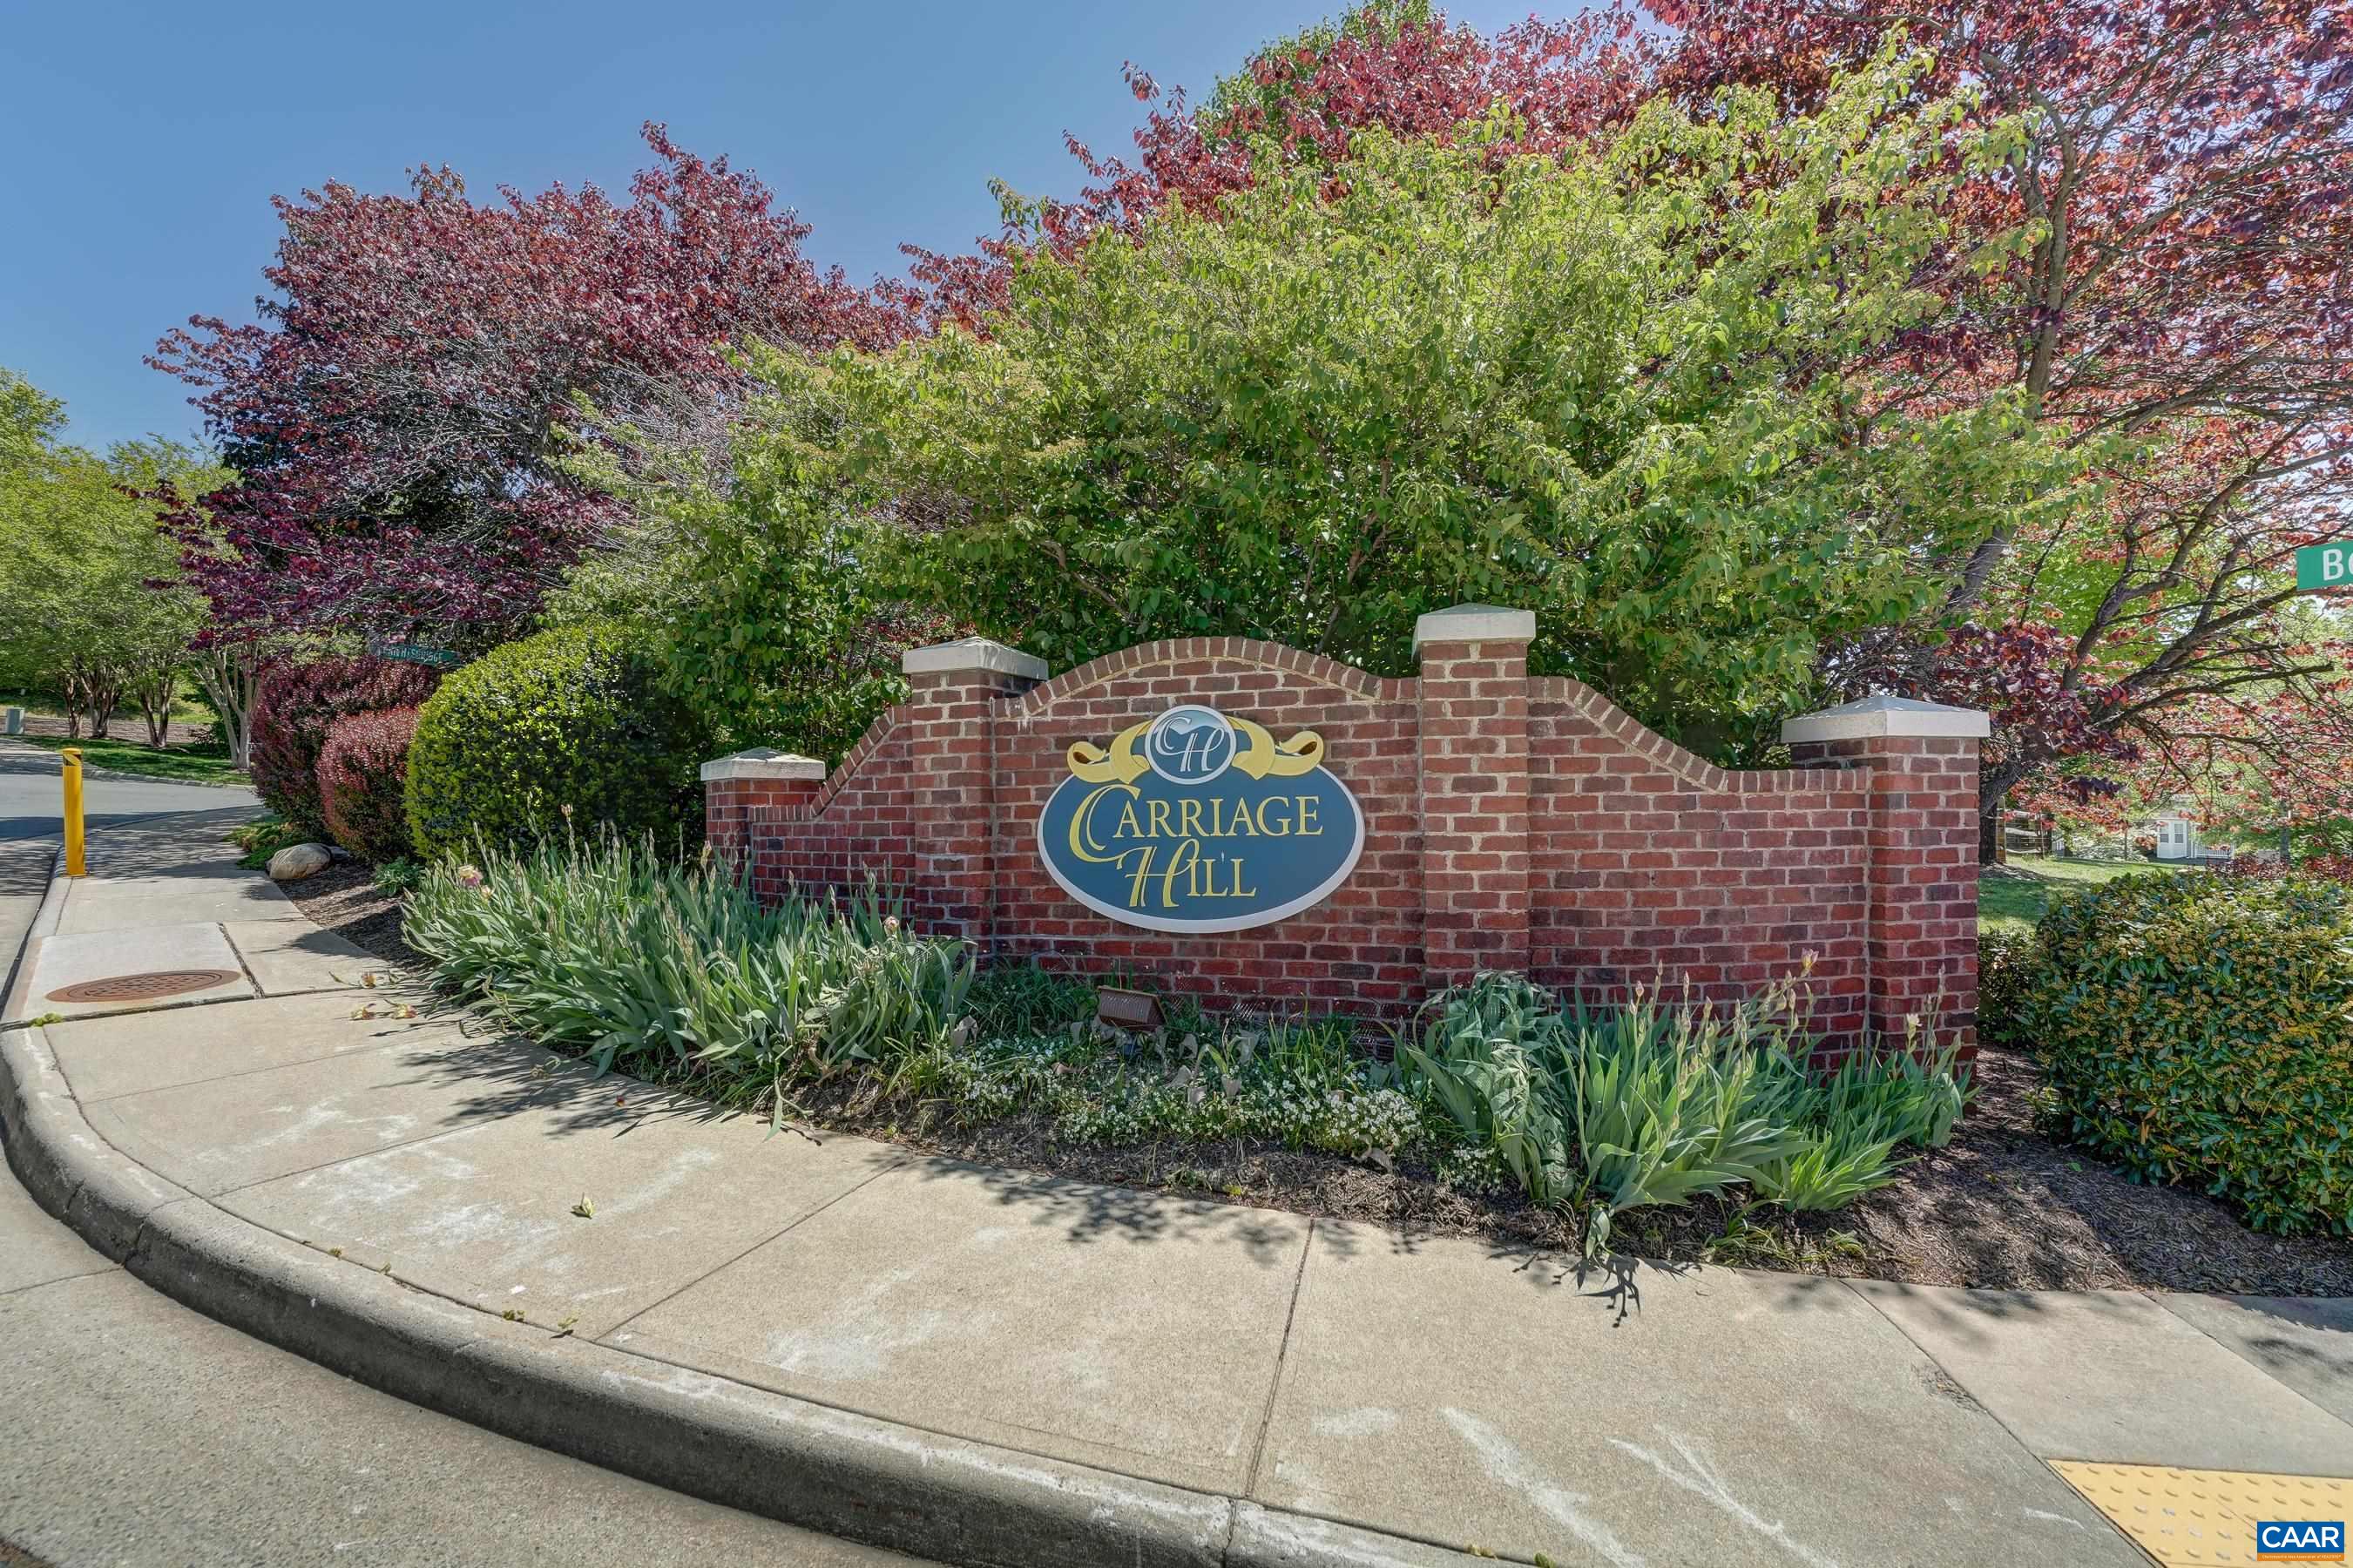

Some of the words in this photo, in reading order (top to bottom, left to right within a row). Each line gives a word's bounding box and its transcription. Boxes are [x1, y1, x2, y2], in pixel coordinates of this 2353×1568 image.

[2323, 549, 2353, 581] B
[1154, 716, 1226, 772] CH
[1069, 783, 1323, 862] CARRIAGE
[1116, 838, 1257, 908] HILL
